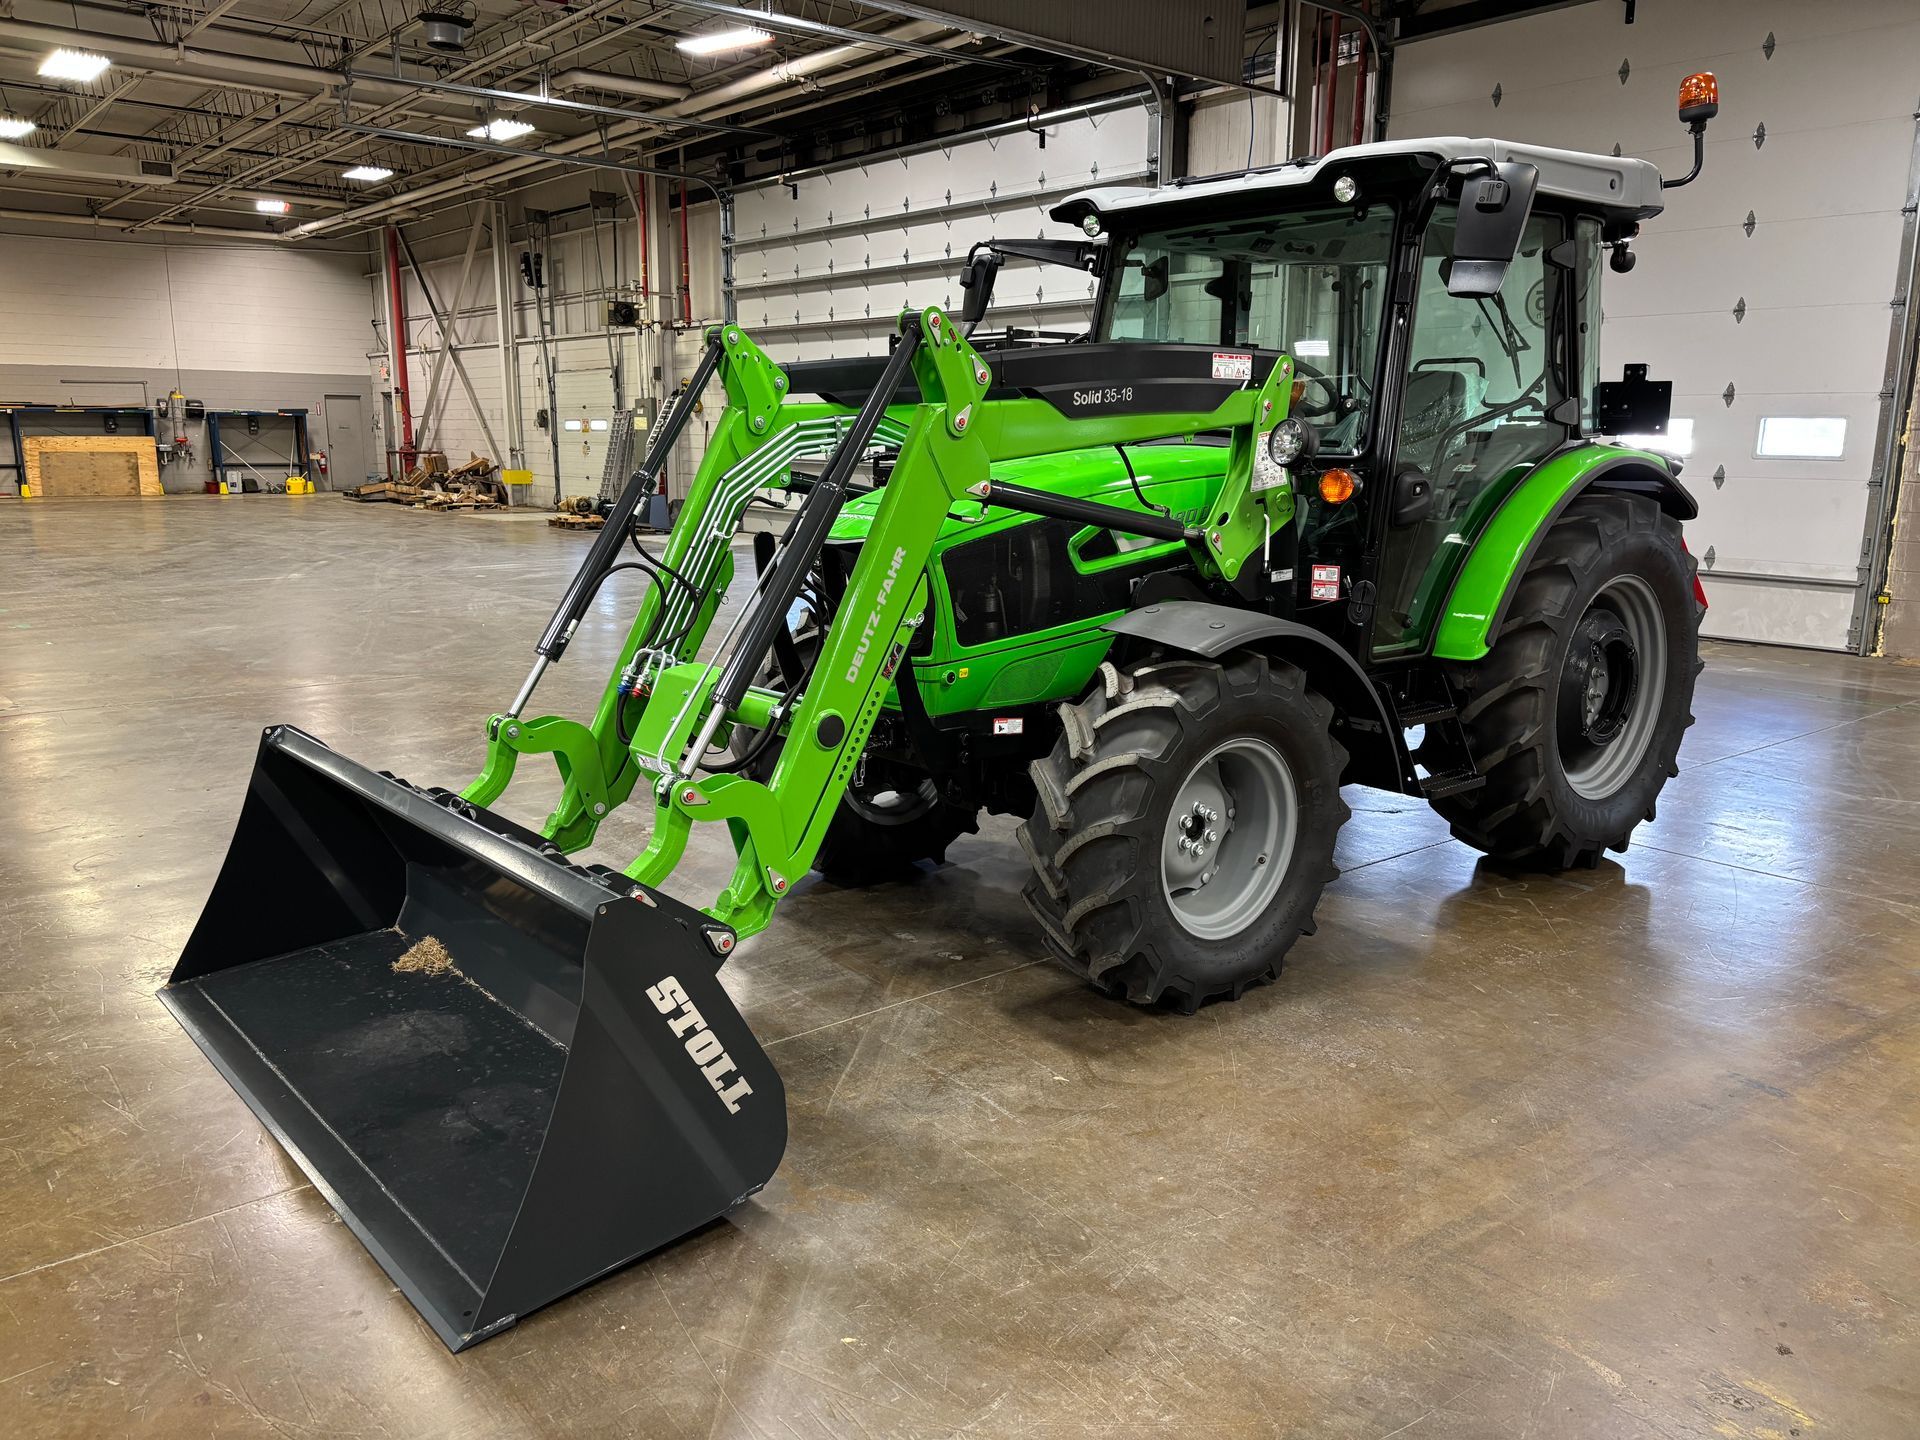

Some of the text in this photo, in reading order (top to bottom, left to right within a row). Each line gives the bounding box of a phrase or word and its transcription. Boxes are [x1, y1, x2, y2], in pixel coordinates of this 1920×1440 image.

[1073, 387, 1133, 405] Solid 35-18
[845, 546, 907, 684] DEUTZ-FAHR
[645, 975, 754, 1115] STOLL
